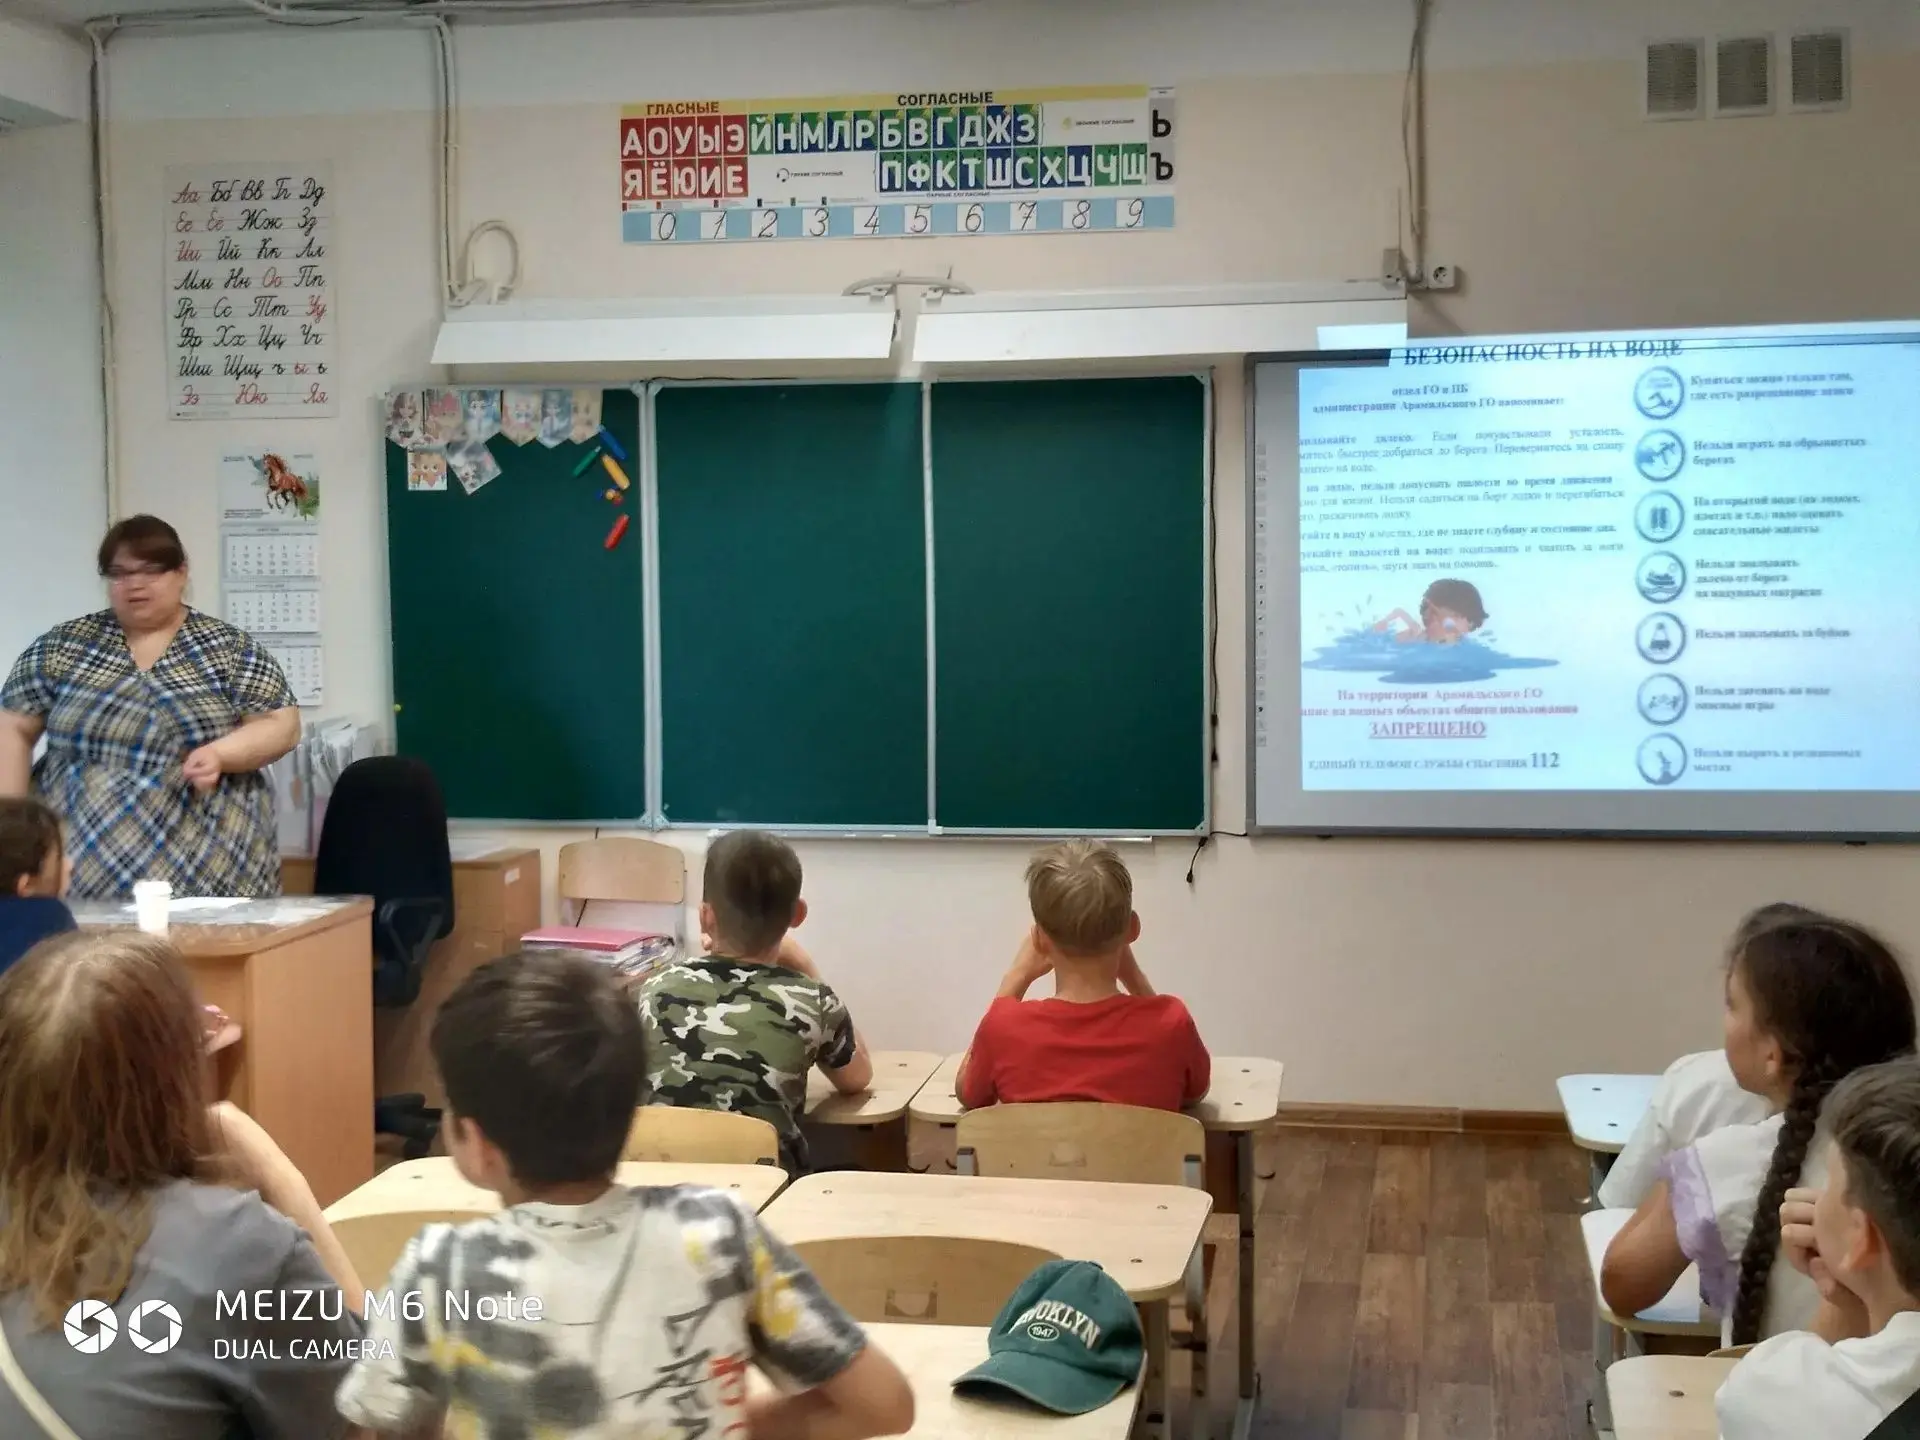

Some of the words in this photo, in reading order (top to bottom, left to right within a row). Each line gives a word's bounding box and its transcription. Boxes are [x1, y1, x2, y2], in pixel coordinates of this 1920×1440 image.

[897, 91, 993, 106] СОГЛАСНЫЕ
[646, 102, 720, 115] ГЛАСНЫЕ
[1152, 109, 1172, 138] Ь
[1150, 152, 1174, 181] Ъ
[658, 212, 676, 240] 0
[713, 210, 728, 239] 1
[758, 208, 778, 239] 2
[809, 207, 829, 237] 3
[863, 206, 880, 235] 4
[910, 204, 932, 233] 5
[965, 202, 984, 233] 6
[1018, 201, 1037, 231] 7
[1071, 200, 1091, 229] 8
[1126, 198, 1144, 228] 9
[1404, 341, 1580, 365] БЕЗОПАСНОСТЬ
[1587, 341, 1617, 359] НА
[1625, 339, 1683, 358] ВОДЕ
[1423, 384, 1440, 394] ГО
[1451, 383, 1469, 394] ПБ
[1478, 397, 1495, 408] ГО
[1368, 720, 1487, 738] ЗАПРЕЩЕНО
[1529, 752, 1560, 768] 112
[1008, 1299, 1100, 1349] ROOKLYN
[1031, 1326, 1054, 1337] 1947
